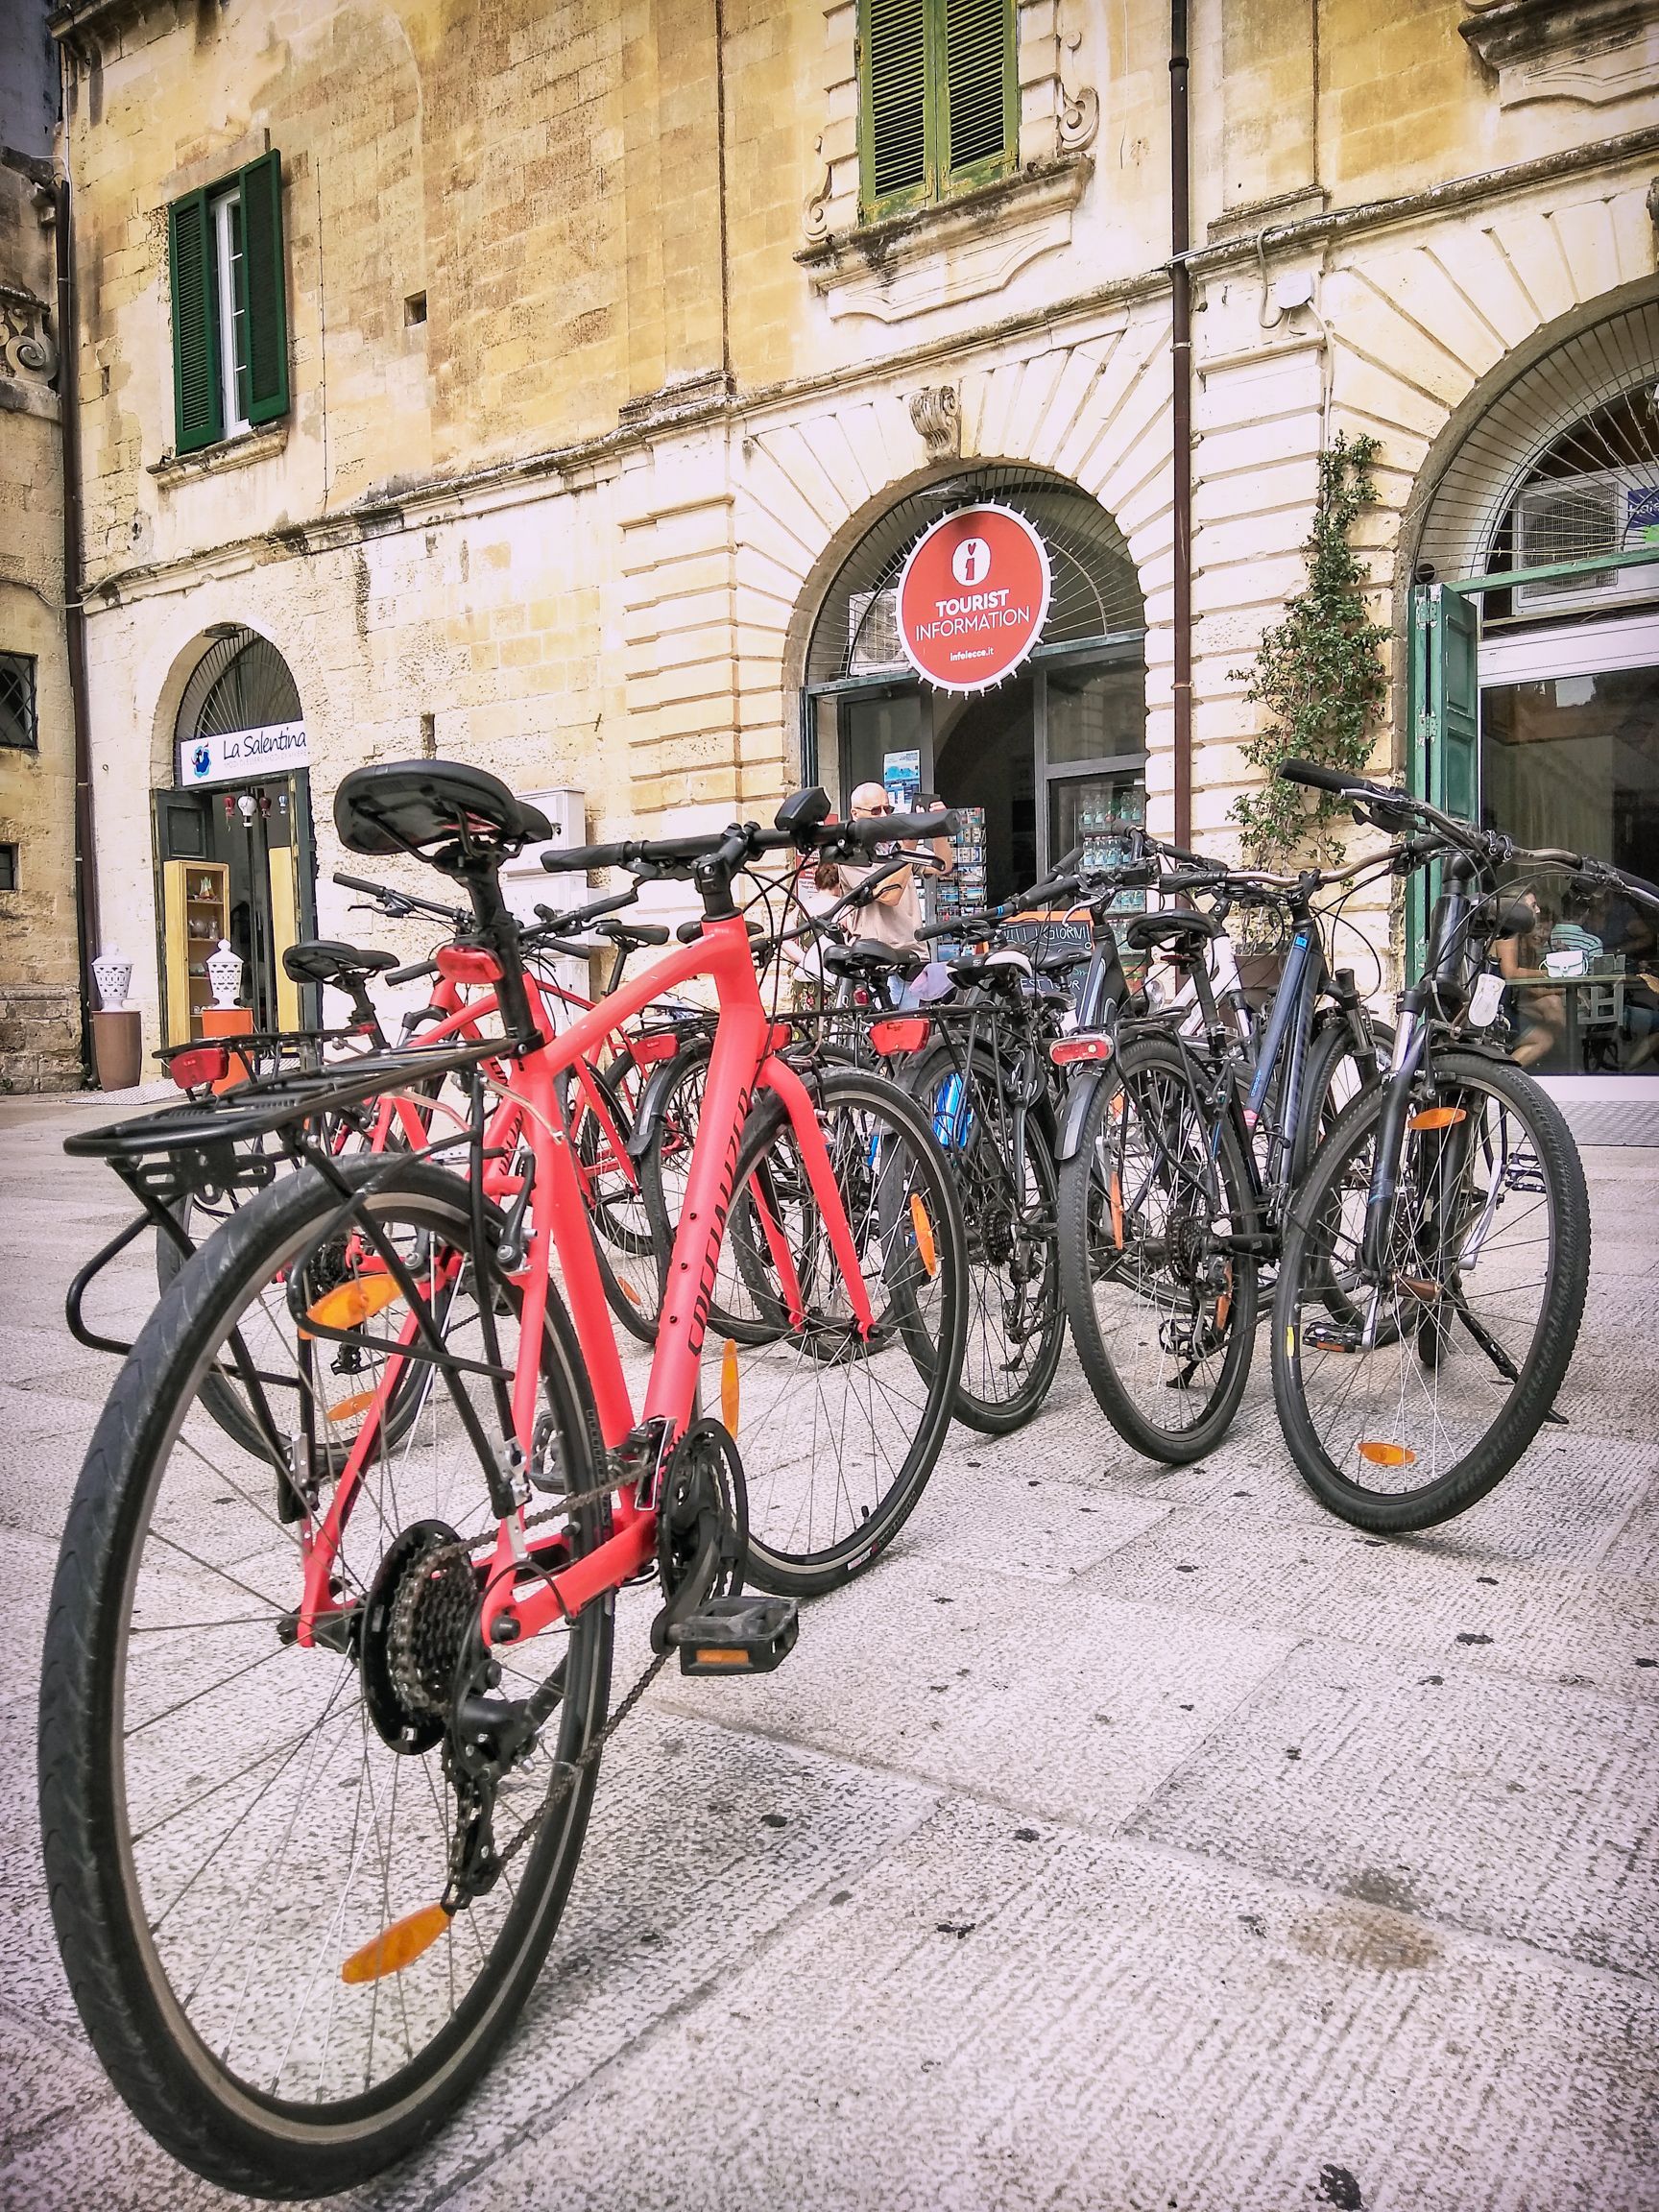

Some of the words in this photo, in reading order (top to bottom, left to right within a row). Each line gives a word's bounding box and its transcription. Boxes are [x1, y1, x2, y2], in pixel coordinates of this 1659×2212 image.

[935, 589, 1010, 617] TOURIST
[915, 606, 1030, 641] INFORMATION
[950, 647, 994, 661] infolecce.it
[223, 740, 240, 760] La
[244, 727, 307, 757] Salentina
